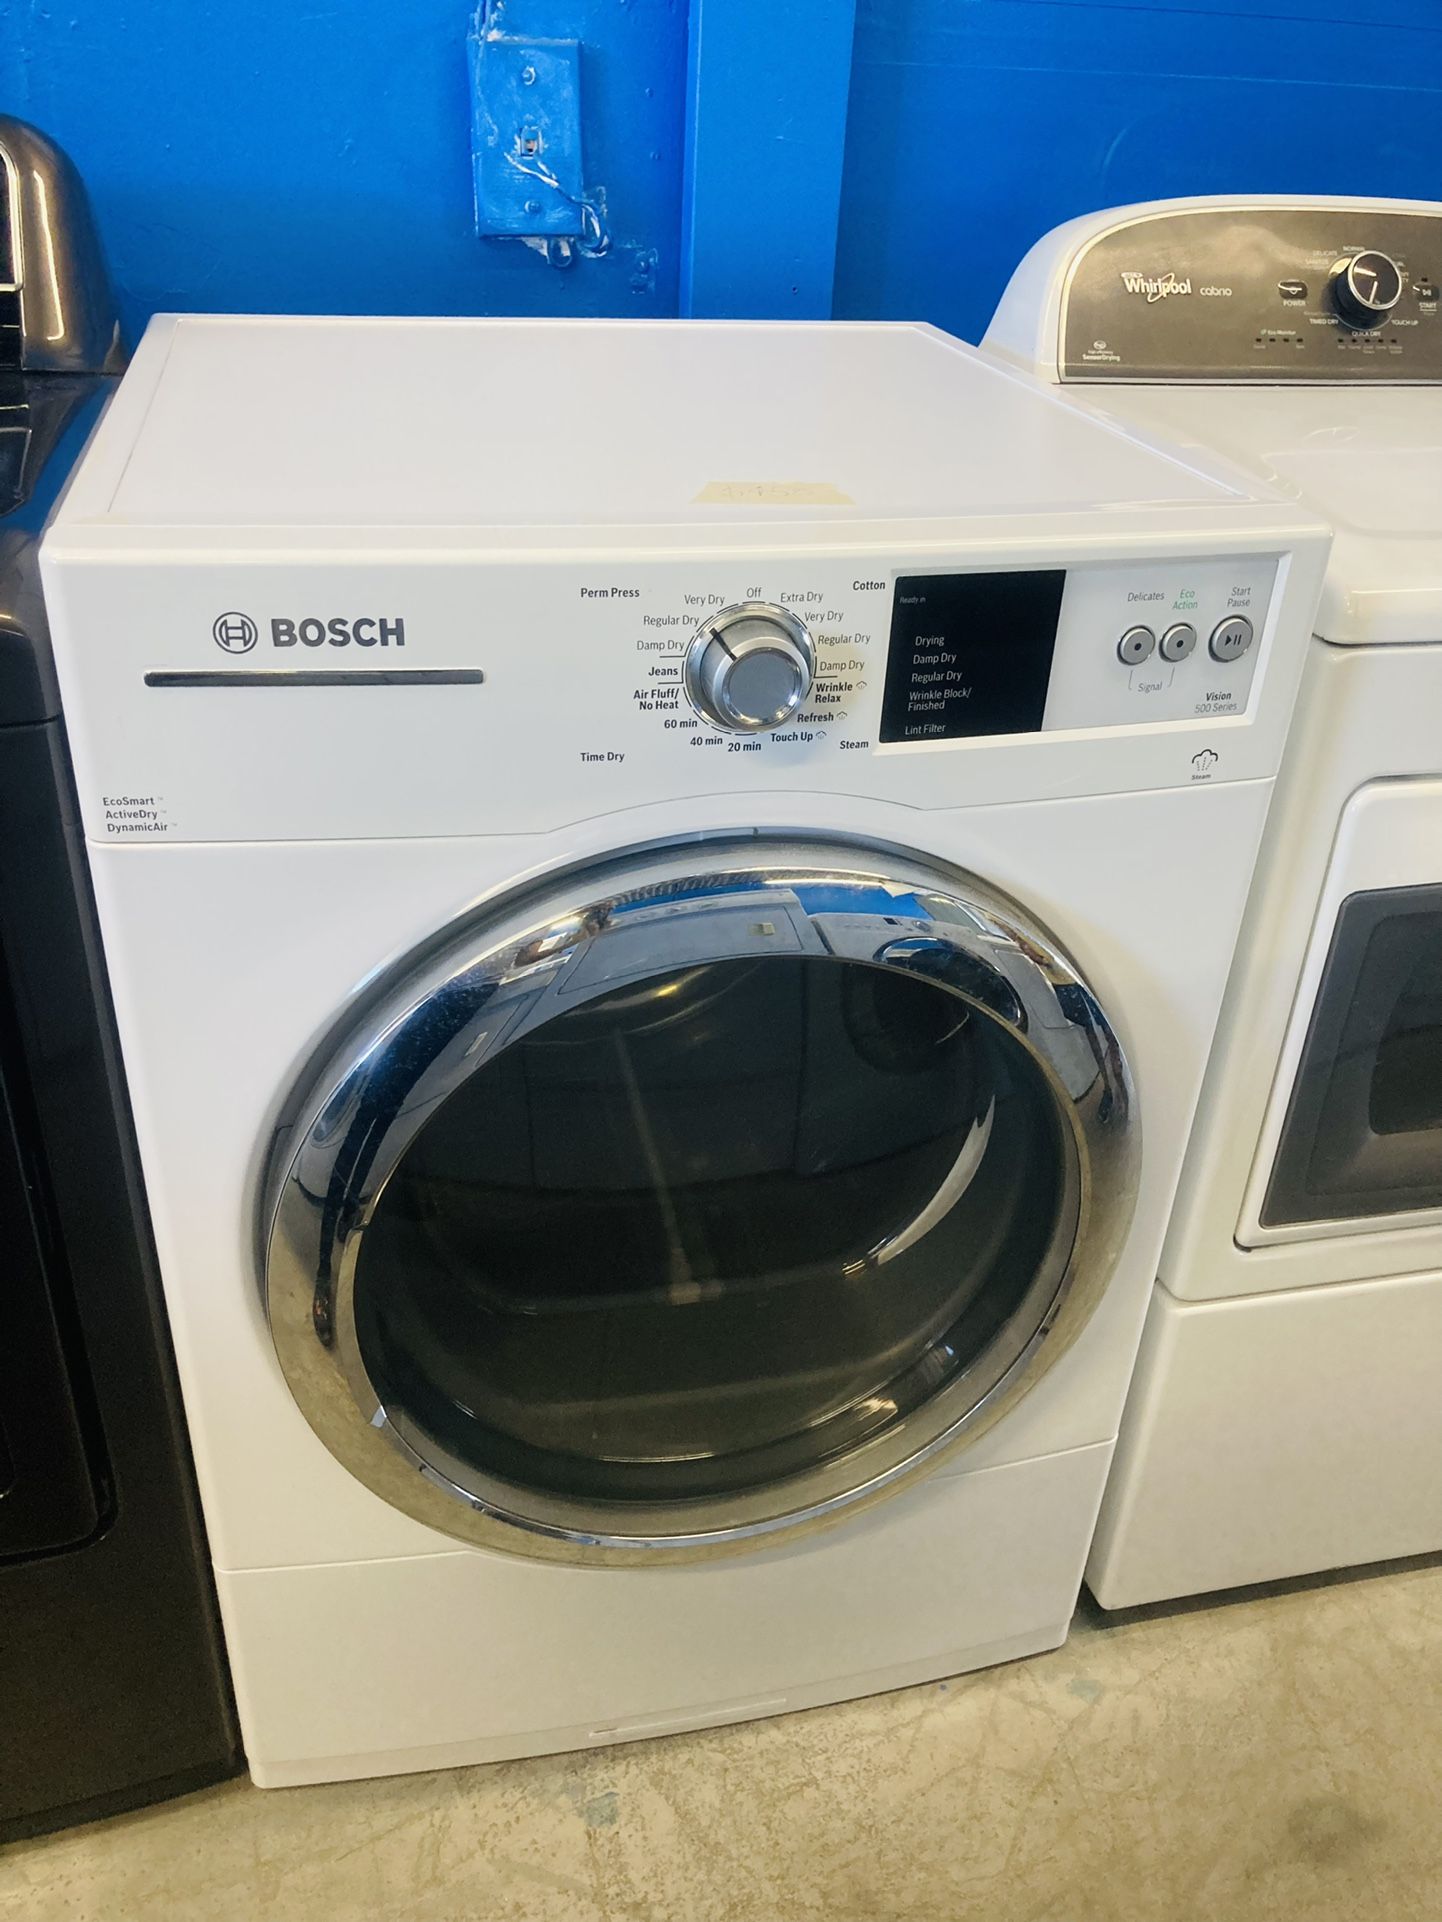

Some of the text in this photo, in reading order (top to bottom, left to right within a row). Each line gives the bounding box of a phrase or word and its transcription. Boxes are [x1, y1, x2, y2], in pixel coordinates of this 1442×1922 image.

[1123, 275, 1192, 299] Whirlpool
[1200, 286, 1232, 296] cabrio
[852, 580, 886, 591] Cotton
[580, 587, 640, 598] Perm Press
[746, 587, 762, 598] Off
[780, 591, 824, 603] Extra Dry
[1128, 592, 1165, 602] Delicates
[1180, 589, 1196, 599] Eco
[1231, 587, 1251, 597] Start
[684, 594, 726, 606] Very Dry
[899, 596, 919, 605] Ready
[1172, 600, 1198, 610] Action
[1227, 598, 1251, 608] Pause
[643, 615, 700, 628] Regular Dry
[804, 610, 844, 623] Very Dry
[271, 618, 405, 647] BOSCH
[818, 633, 871, 647] Regular Dry
[915, 635, 945, 647] Drying
[636, 640, 685, 653] Damp Dry
[913, 652, 957, 665] Damp Dry
[648, 666, 679, 677] Jeans
[819, 660, 865, 673] Damp Dry
[911, 671, 963, 684] Regular Dry
[816, 681, 853, 693] Wrinkle
[1137, 682, 1163, 694] Signal
[633, 688, 680, 700] Air Fluff/
[815, 693, 841, 704] Relax
[909, 687, 973, 701] Wrinkle Block/
[1206, 692, 1232, 701] Vision
[639, 699, 679, 711] No Heat
[908, 701, 946, 712] Finished
[1194, 702, 1237, 714] 500 Series
[797, 711, 834, 723] Refresh
[664, 718, 698, 729] 60 min
[905, 724, 946, 735] Lint Filter
[690, 735, 723, 747] 40 min
[770, 732, 814, 744] Touch Up
[728, 741, 762, 752] 20 min
[839, 739, 870, 750] Steam
[580, 751, 625, 763] Time Dry
[102, 796, 155, 806] EcoSmart
[105, 809, 158, 820] ActiveDry
[107, 822, 168, 834] DynamicAir
